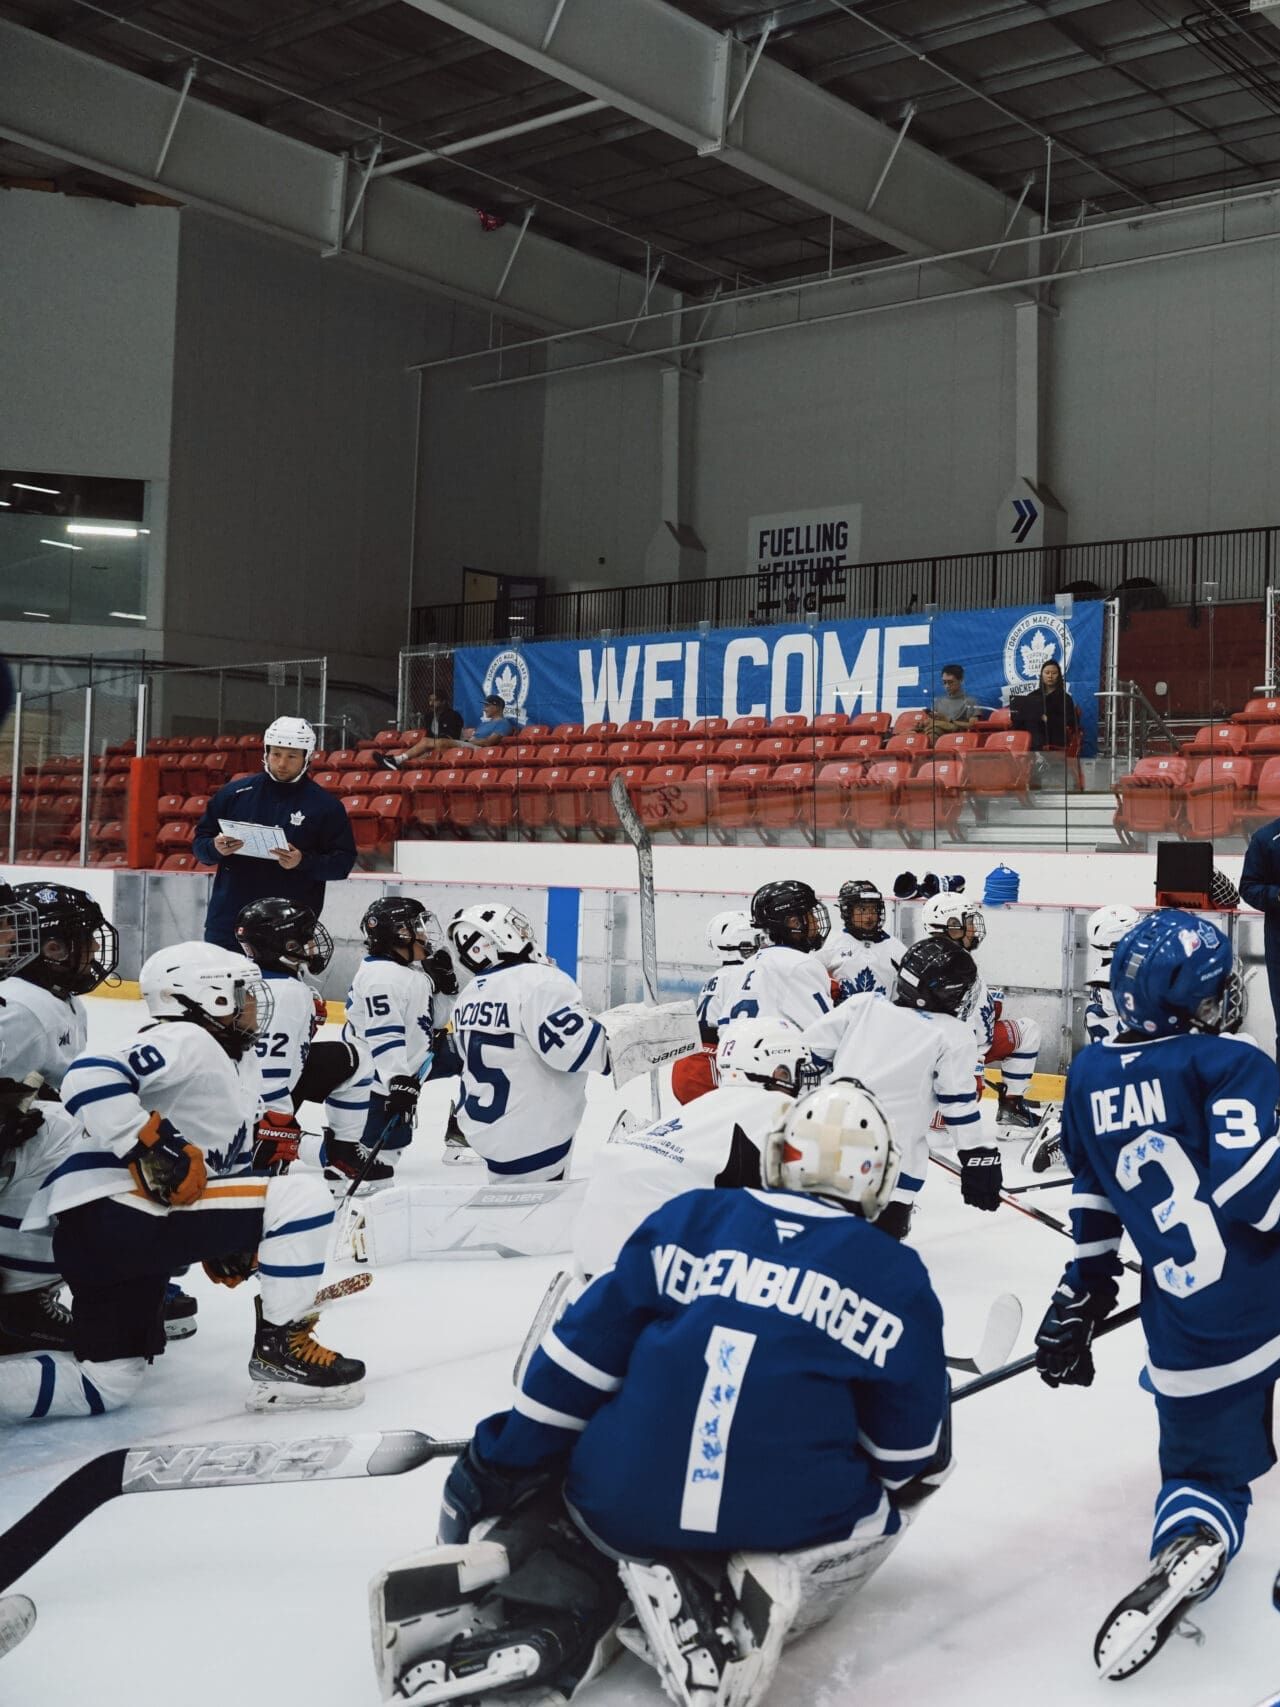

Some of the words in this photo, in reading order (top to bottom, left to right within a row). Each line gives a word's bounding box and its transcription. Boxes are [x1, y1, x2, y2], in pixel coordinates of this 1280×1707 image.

[759, 521, 848, 558] FUELLING
[772, 555, 847, 590] FUTURE
[578, 624, 931, 735] WELCOME
[1010, 682, 1037, 695] HOCKEY
[40, 920, 59, 928] CM
[365, 994, 391, 1018] 15
[1123, 992, 1135, 1011] 3
[253, 1032, 290, 1058] 52
[538, 1006, 584, 1054] 45
[651, 1042, 695, 1064] BAUER
[1090, 1077, 1167, 1136] DEAN
[1211, 1098, 1261, 1150] 3
[967, 1156, 1001, 1168] BAU
[1115, 1129, 1227, 1299] 3
[680, 1325, 757, 1533] 1
[122, 1438, 354, 1485] CCM
